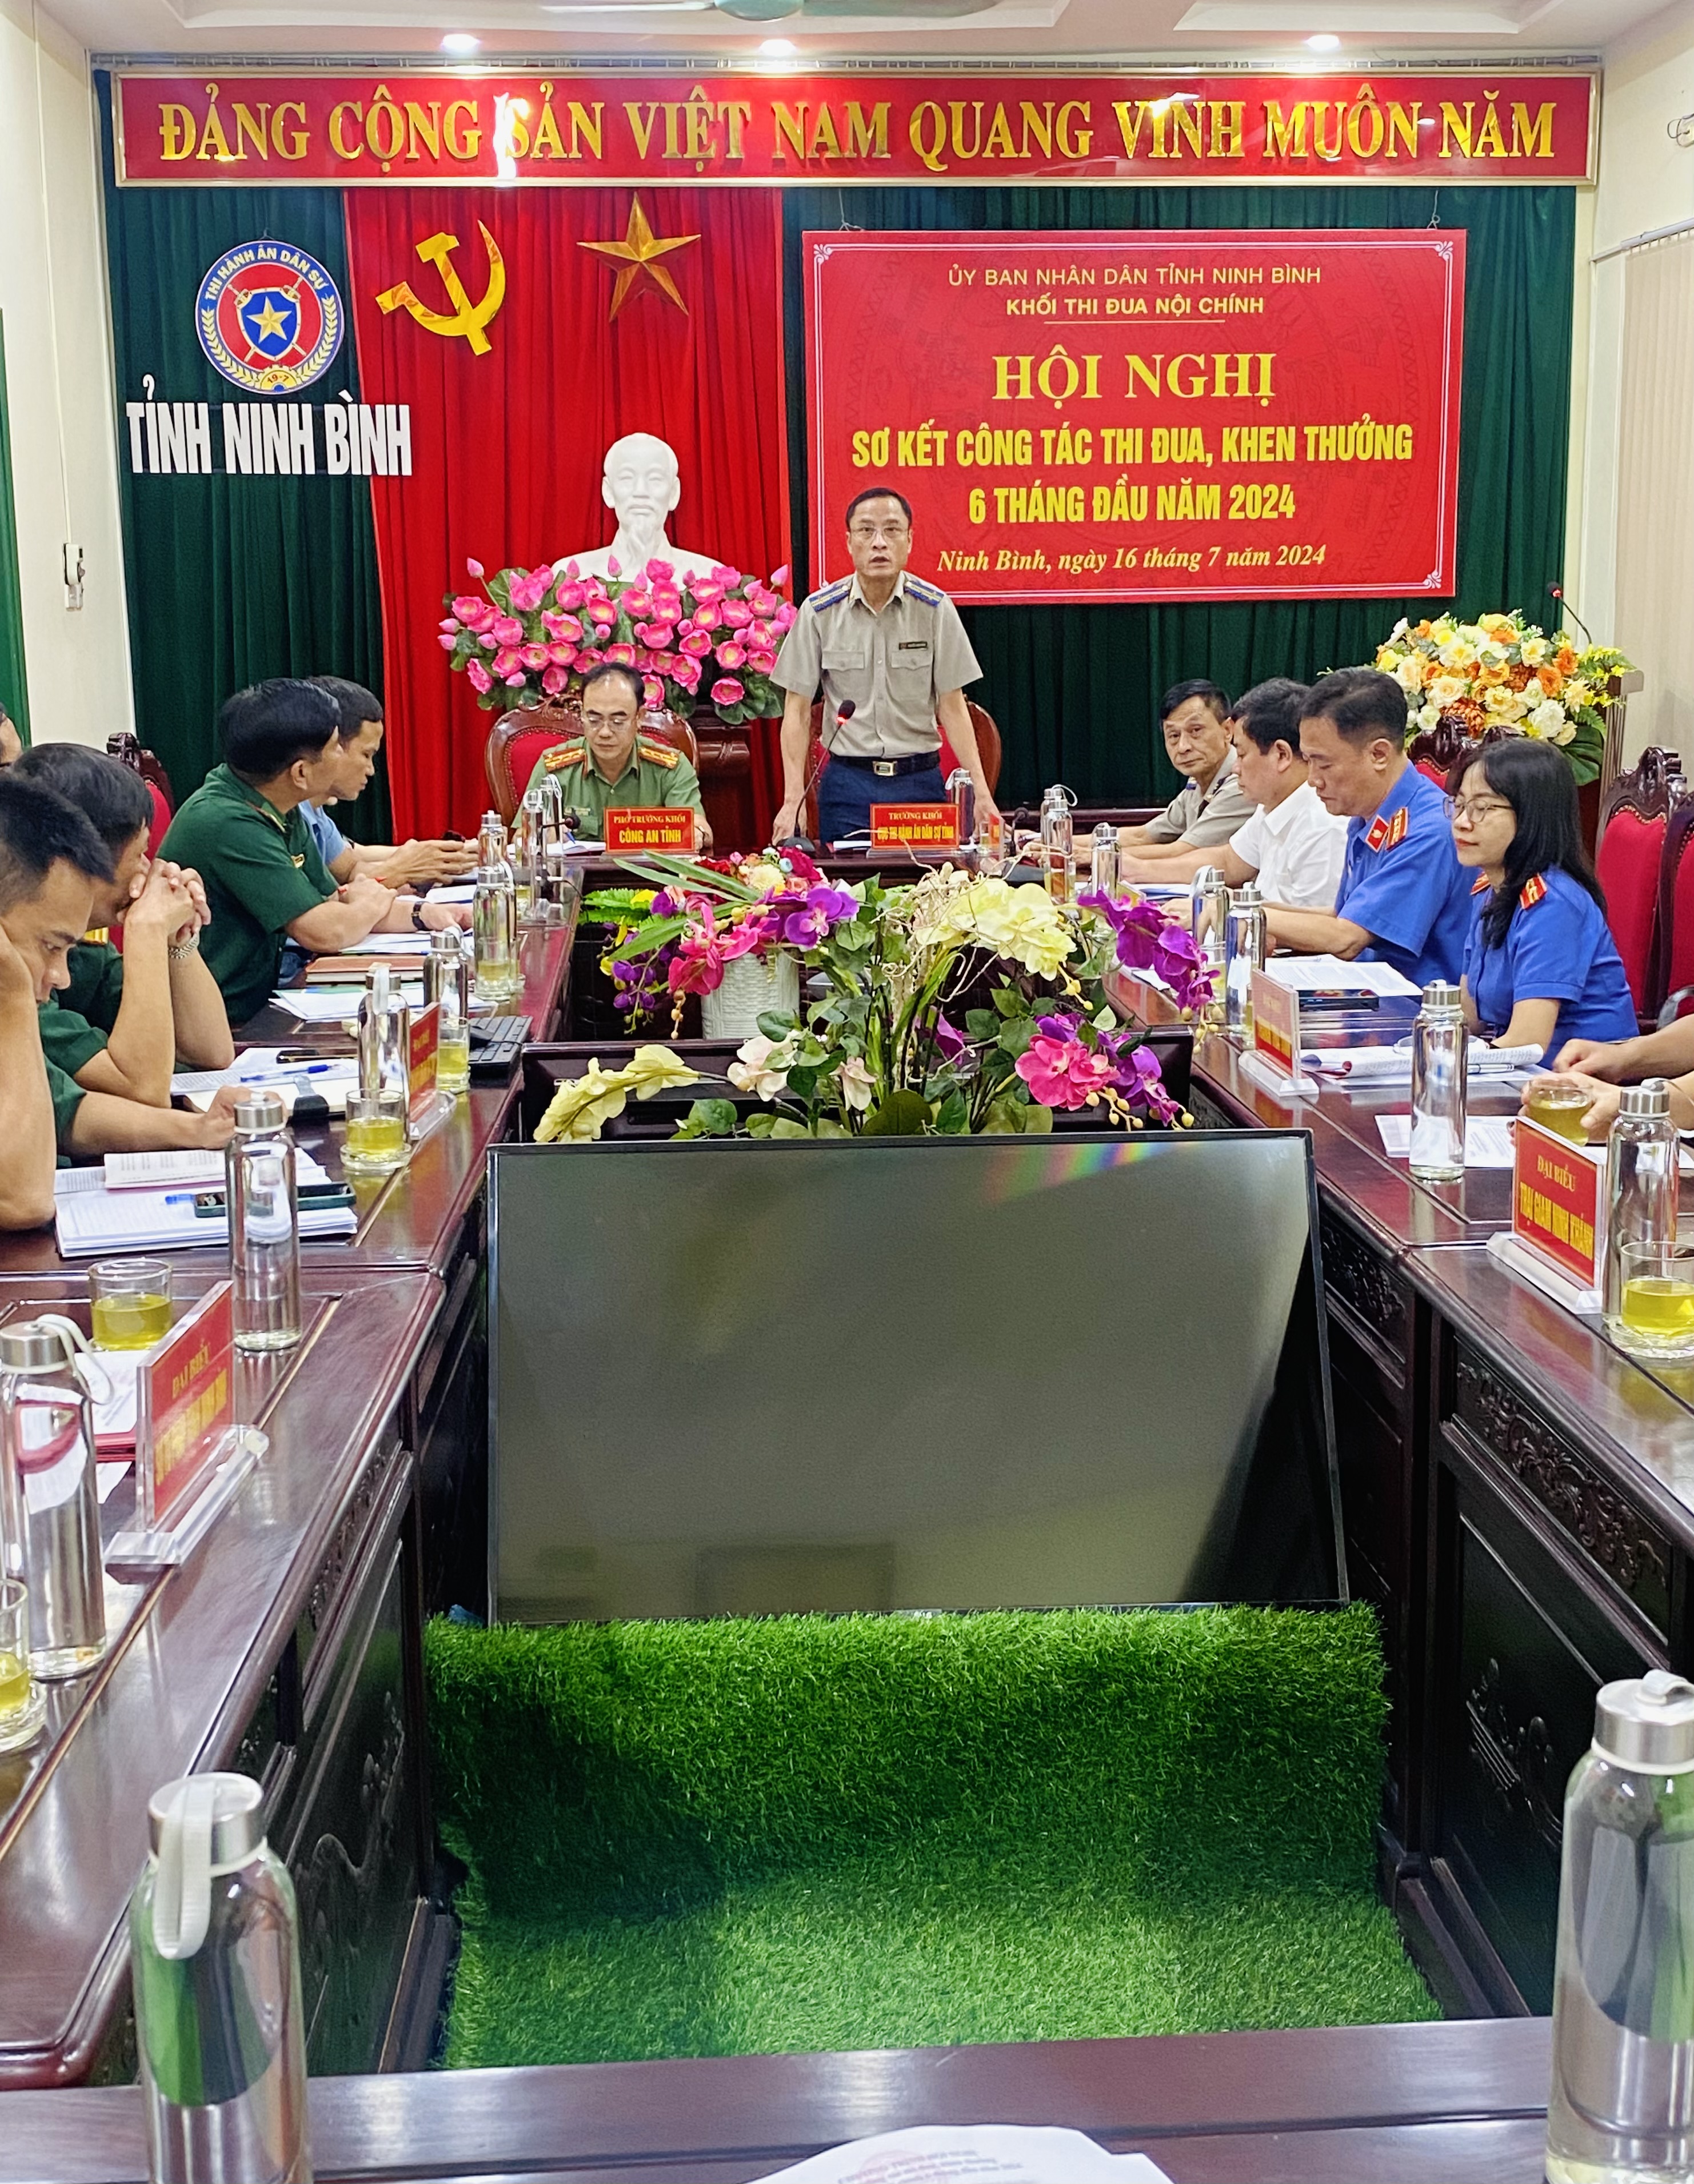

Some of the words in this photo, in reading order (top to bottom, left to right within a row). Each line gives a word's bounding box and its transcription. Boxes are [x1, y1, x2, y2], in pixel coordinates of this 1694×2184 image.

[159, 83, 309, 162] ĐẢNG
[329, 85, 482, 171] CỘNG
[505, 81, 604, 158] SẢN
[624, 86, 750, 171] VIỆT
[772, 102, 890, 158] NAM
[910, 101, 1092, 171] QUANG
[1112, 99, 1246, 159] VINH
[1263, 83, 1421, 158] MUÔN
[1439, 91, 1555, 158] NĂM
[205, 277, 223, 300] THI
[217, 249, 255, 280] HÀNH
[280, 250, 310, 273] DÂN
[949, 264, 976, 285] ỦY
[986, 270, 1027, 285] BAN
[1037, 265, 1094, 285] NHÂN
[1105, 265, 1146, 284] DÂN
[1156, 263, 1203, 284] TỈNH
[1213, 267, 1262, 284] NINH
[1272, 263, 1320, 283] BÌNH
[1007, 292, 1056, 315] KHỐI
[1064, 299, 1097, 314] THI
[1106, 298, 1148, 314] ĐUA
[1156, 294, 1190, 317] NỘI
[1199, 293, 1263, 313] CHÍNH
[992, 344, 1102, 409] HỘI
[1124, 353, 1276, 406] NGHỊ
[126, 374, 212, 474] TỈNH
[222, 402, 315, 474] NINH
[323, 389, 413, 476] BÌNH
[853, 427, 890, 467] SƠ
[898, 420, 948, 466] KẾT
[957, 423, 1032, 466] CÔNG
[1040, 422, 1092, 465] TÁC
[1100, 428, 1143, 464] THI
[1151, 428, 1213, 466] ĐUA,
[1222, 426, 1296, 462] KHEN
[1304, 414, 1412, 461] THƯỞNG
[969, 488, 986, 524] 6
[994, 480, 1084, 523] THÁNG
[1092, 474, 1148, 521] ĐẦU
[1157, 478, 1220, 520] NĂM
[1228, 484, 1295, 519] 2024
[937, 550, 988, 571] Ninh
[996, 549, 1051, 573] Bình,
[1058, 549, 1106, 574] ngày
[1113, 548, 1138, 568] 16
[1143, 548, 1202, 572] tháng
[1209, 547, 1221, 566] 7
[1226, 548, 1270, 566] năm
[1276, 545, 1326, 565] 2024
[619, 827, 644, 844] CÔNG
[646, 830, 659, 843] AN
[661, 825, 681, 843] TỈNH
[1537, 1154, 1553, 1179] ĐẠI
[1553, 1165, 1576, 1192] BIỂU
